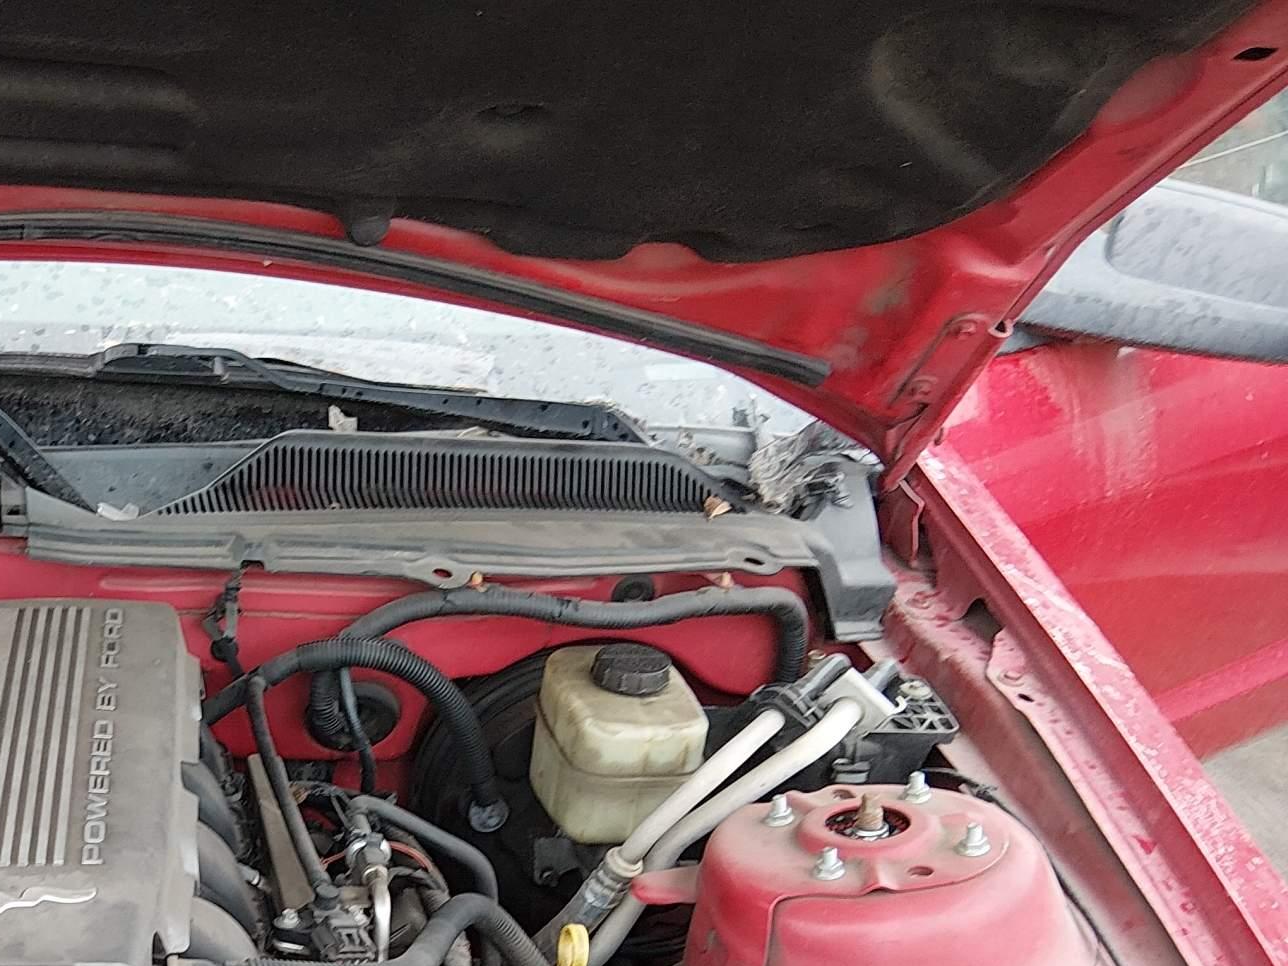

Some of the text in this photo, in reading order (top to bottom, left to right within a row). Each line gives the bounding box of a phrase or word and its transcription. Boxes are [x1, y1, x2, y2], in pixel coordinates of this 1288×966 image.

[81, 607, 124, 865] POWERED BY FORD
